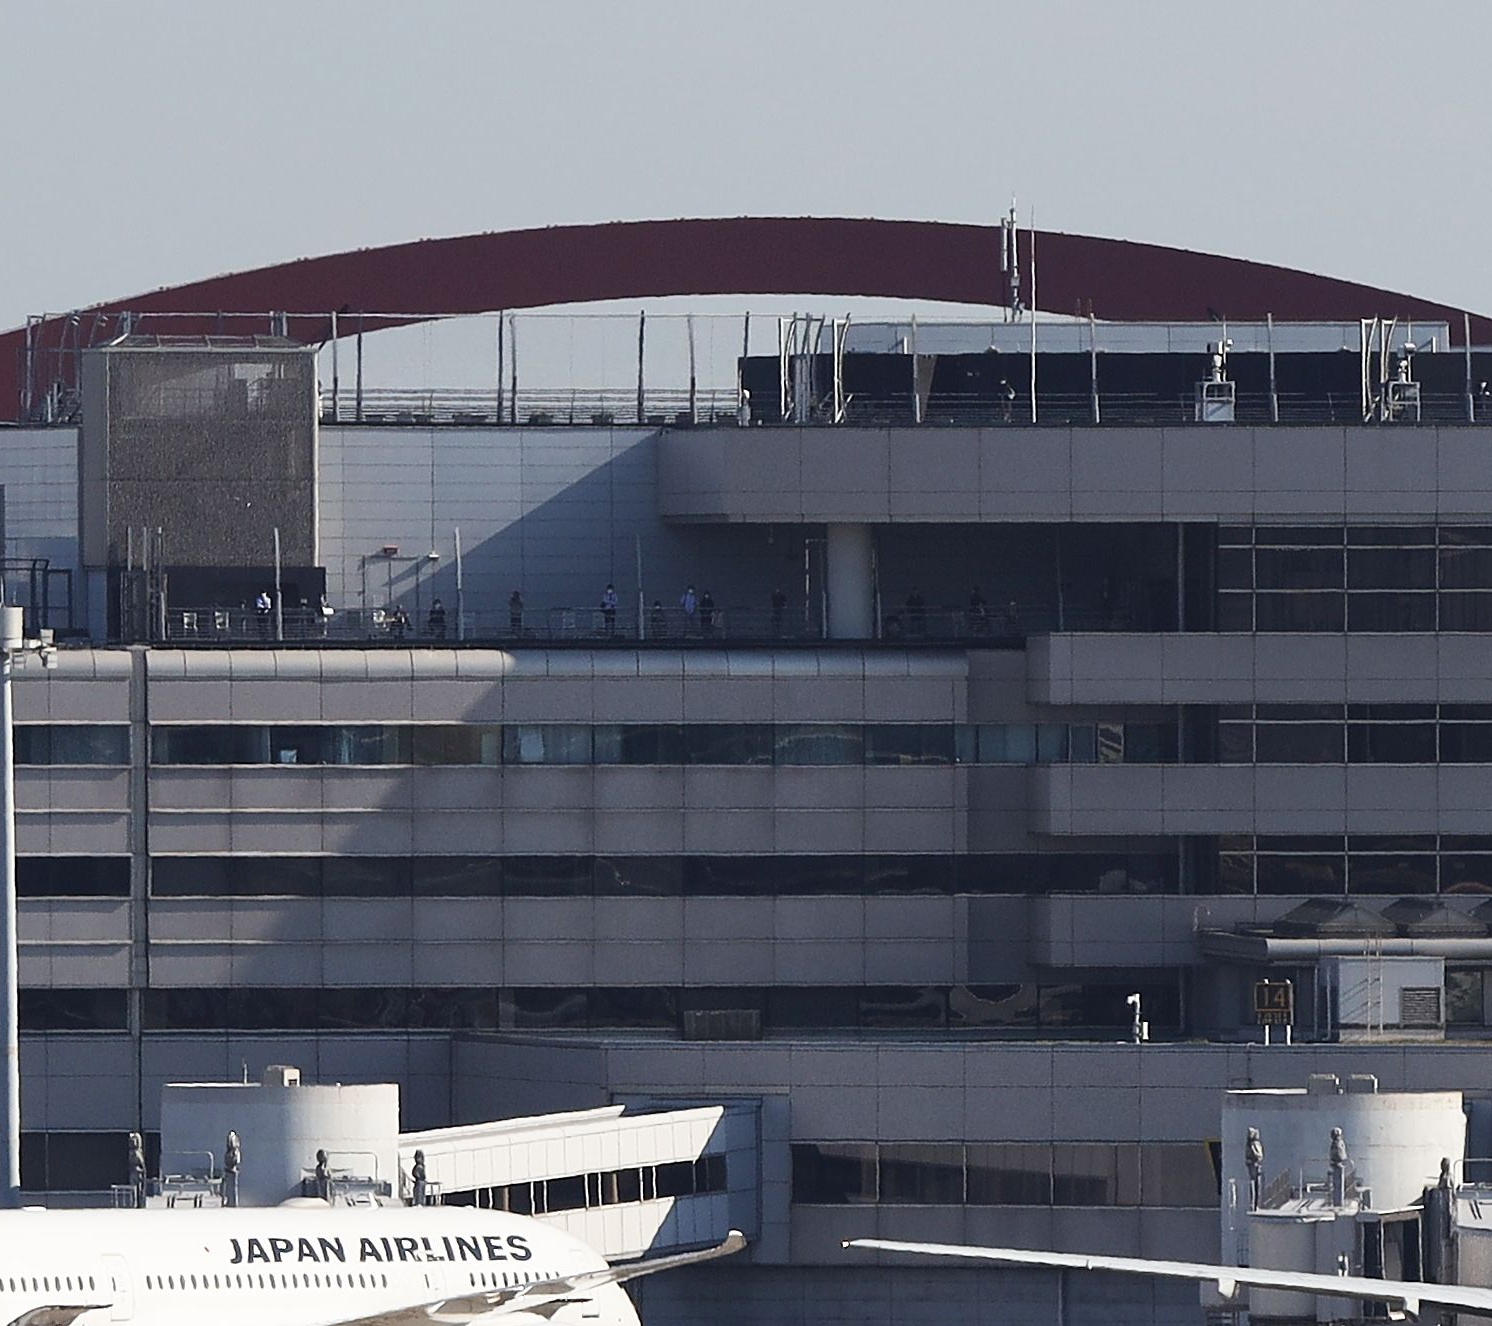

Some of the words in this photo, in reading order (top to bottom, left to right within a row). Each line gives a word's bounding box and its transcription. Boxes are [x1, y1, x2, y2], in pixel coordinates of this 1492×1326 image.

[1264, 987, 1286, 1008] 14
[230, 1237, 346, 1264] JAPAN
[359, 1234, 533, 1263] AIRLINES
